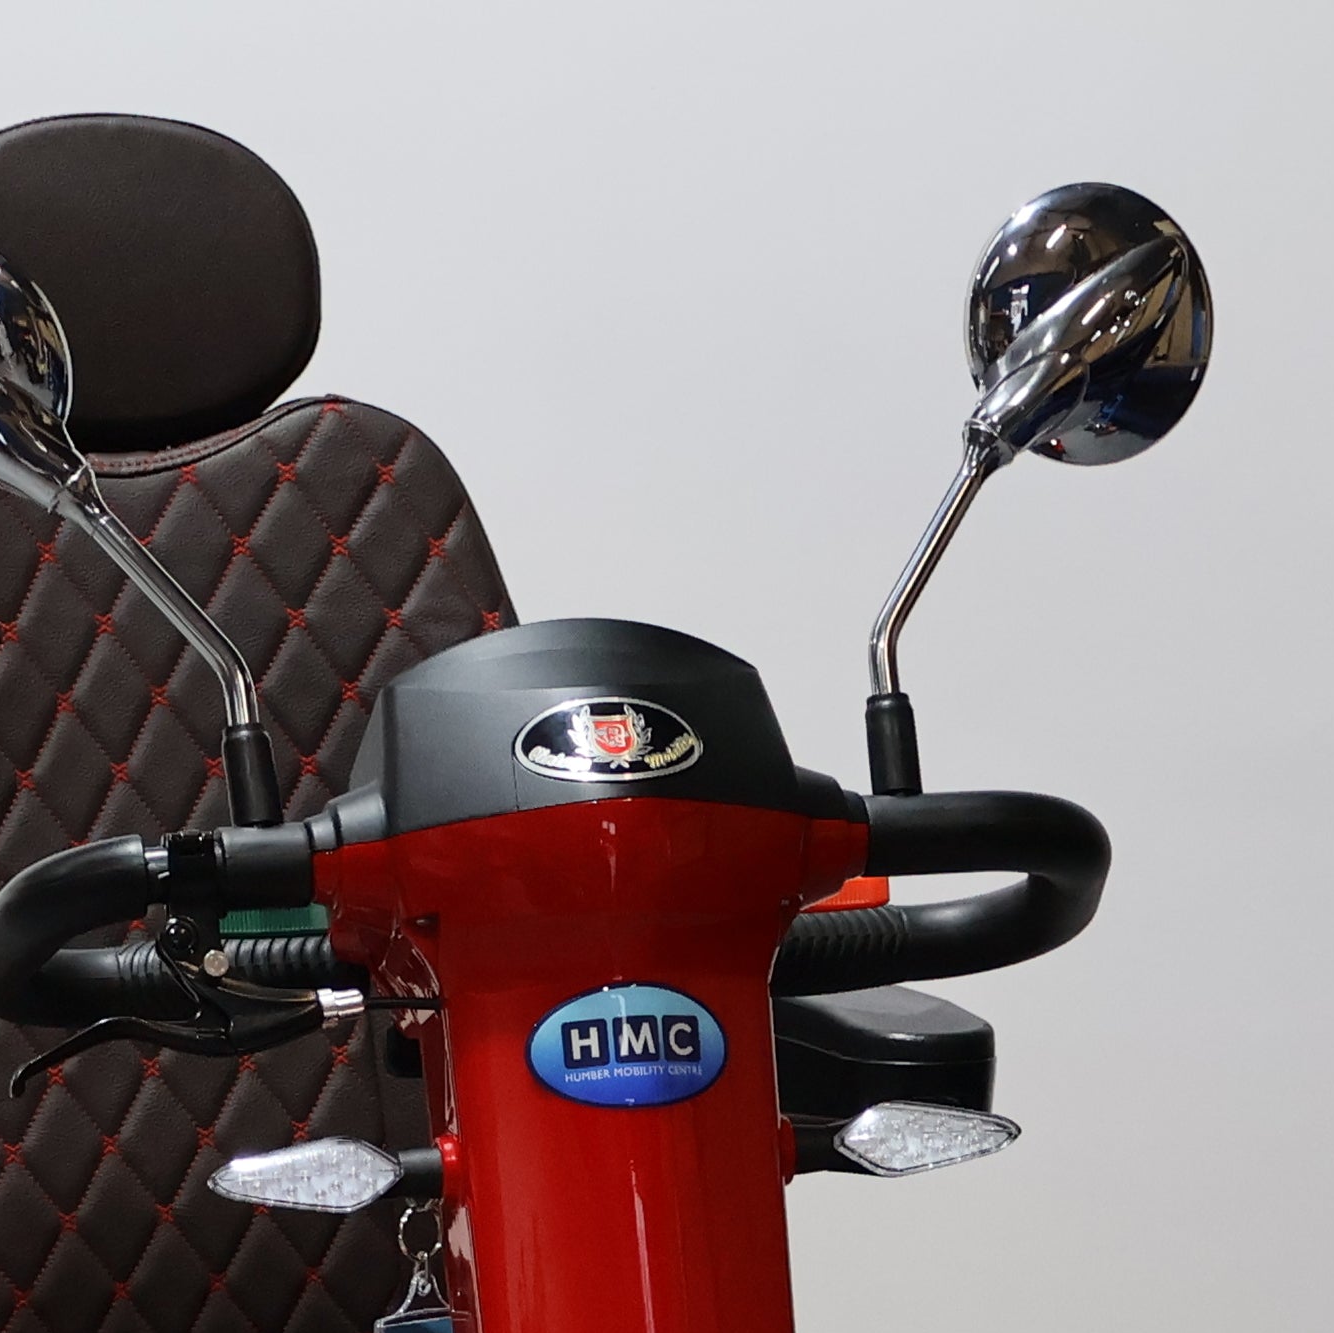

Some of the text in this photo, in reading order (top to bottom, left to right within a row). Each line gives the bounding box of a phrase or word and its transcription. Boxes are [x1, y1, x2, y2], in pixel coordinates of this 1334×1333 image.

[570, 1022, 695, 1061] HMC
[564, 1064, 703, 1083] HUMBER MOBILITY CENTRE
